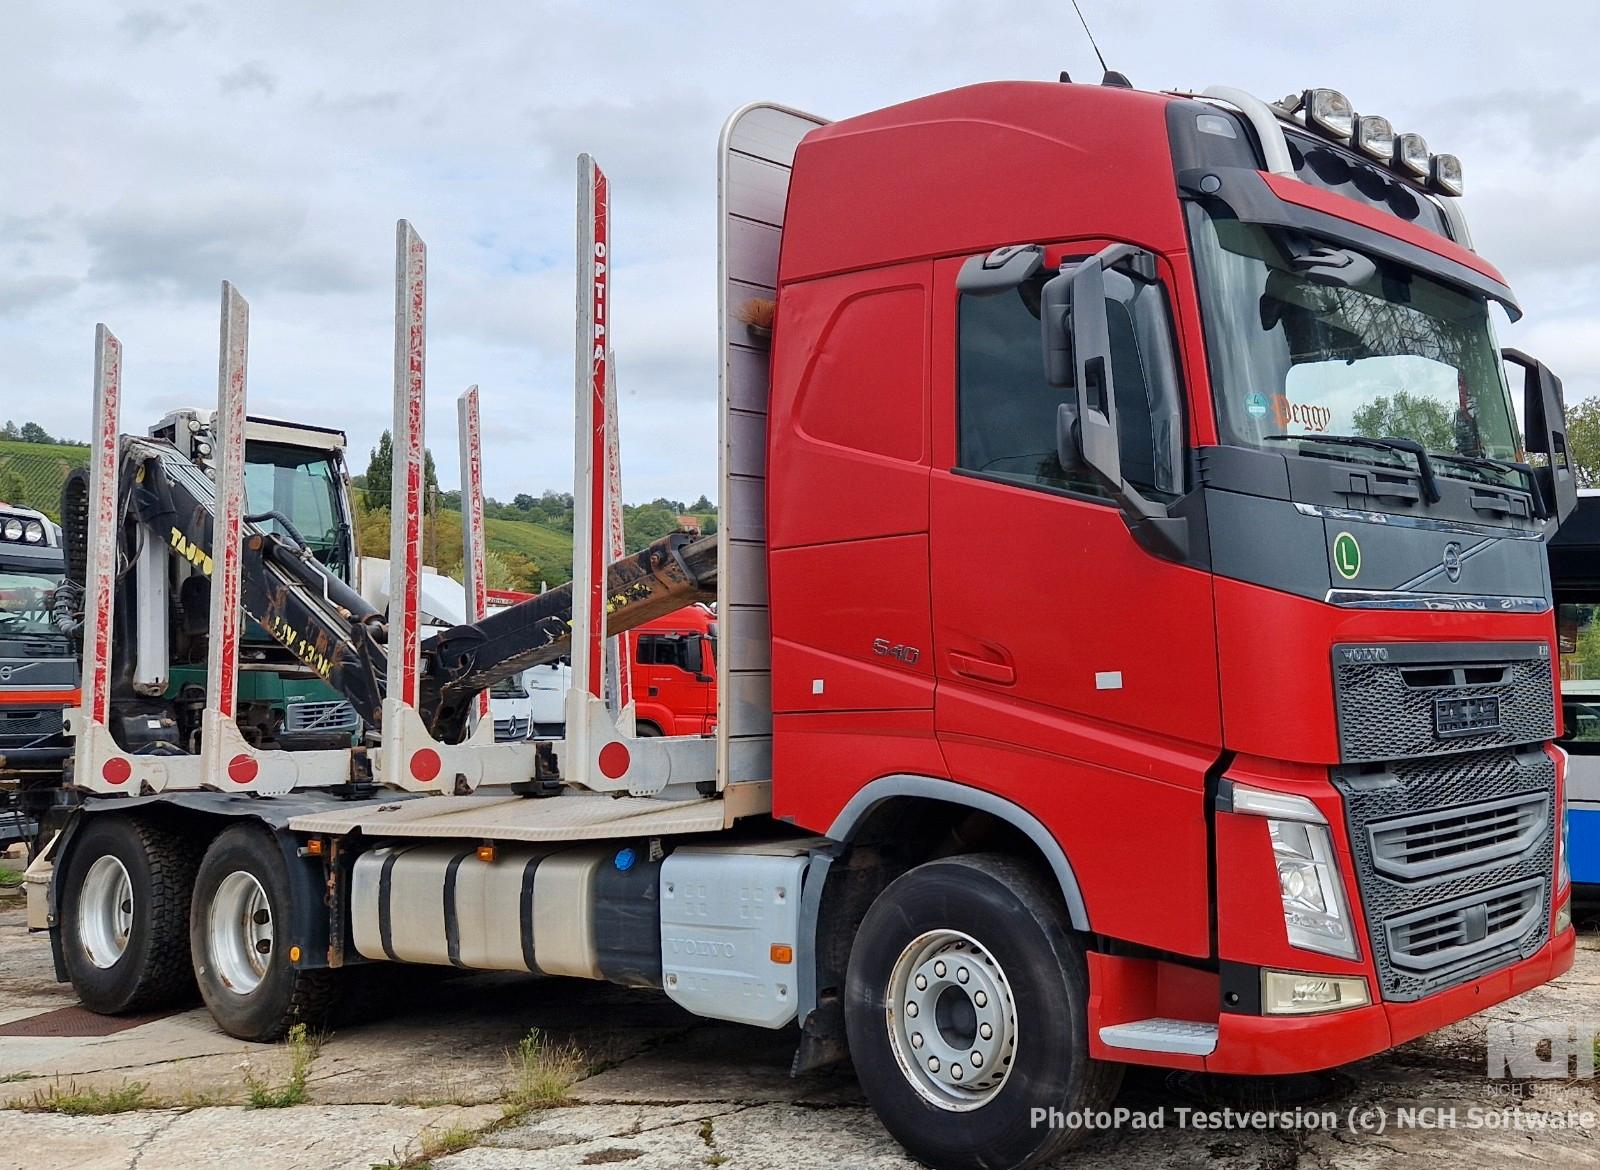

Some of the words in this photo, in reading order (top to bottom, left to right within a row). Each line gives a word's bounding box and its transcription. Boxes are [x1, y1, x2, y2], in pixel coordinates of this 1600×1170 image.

[593, 241, 606, 361] OPTIPA
[1272, 394, 1331, 432] Peggy
[170, 526, 214, 575] TAJFU
[1341, 541, 1355, 570] L
[1340, 647, 1389, 663] VOLVO
[664, 938, 736, 959] VOLVO
